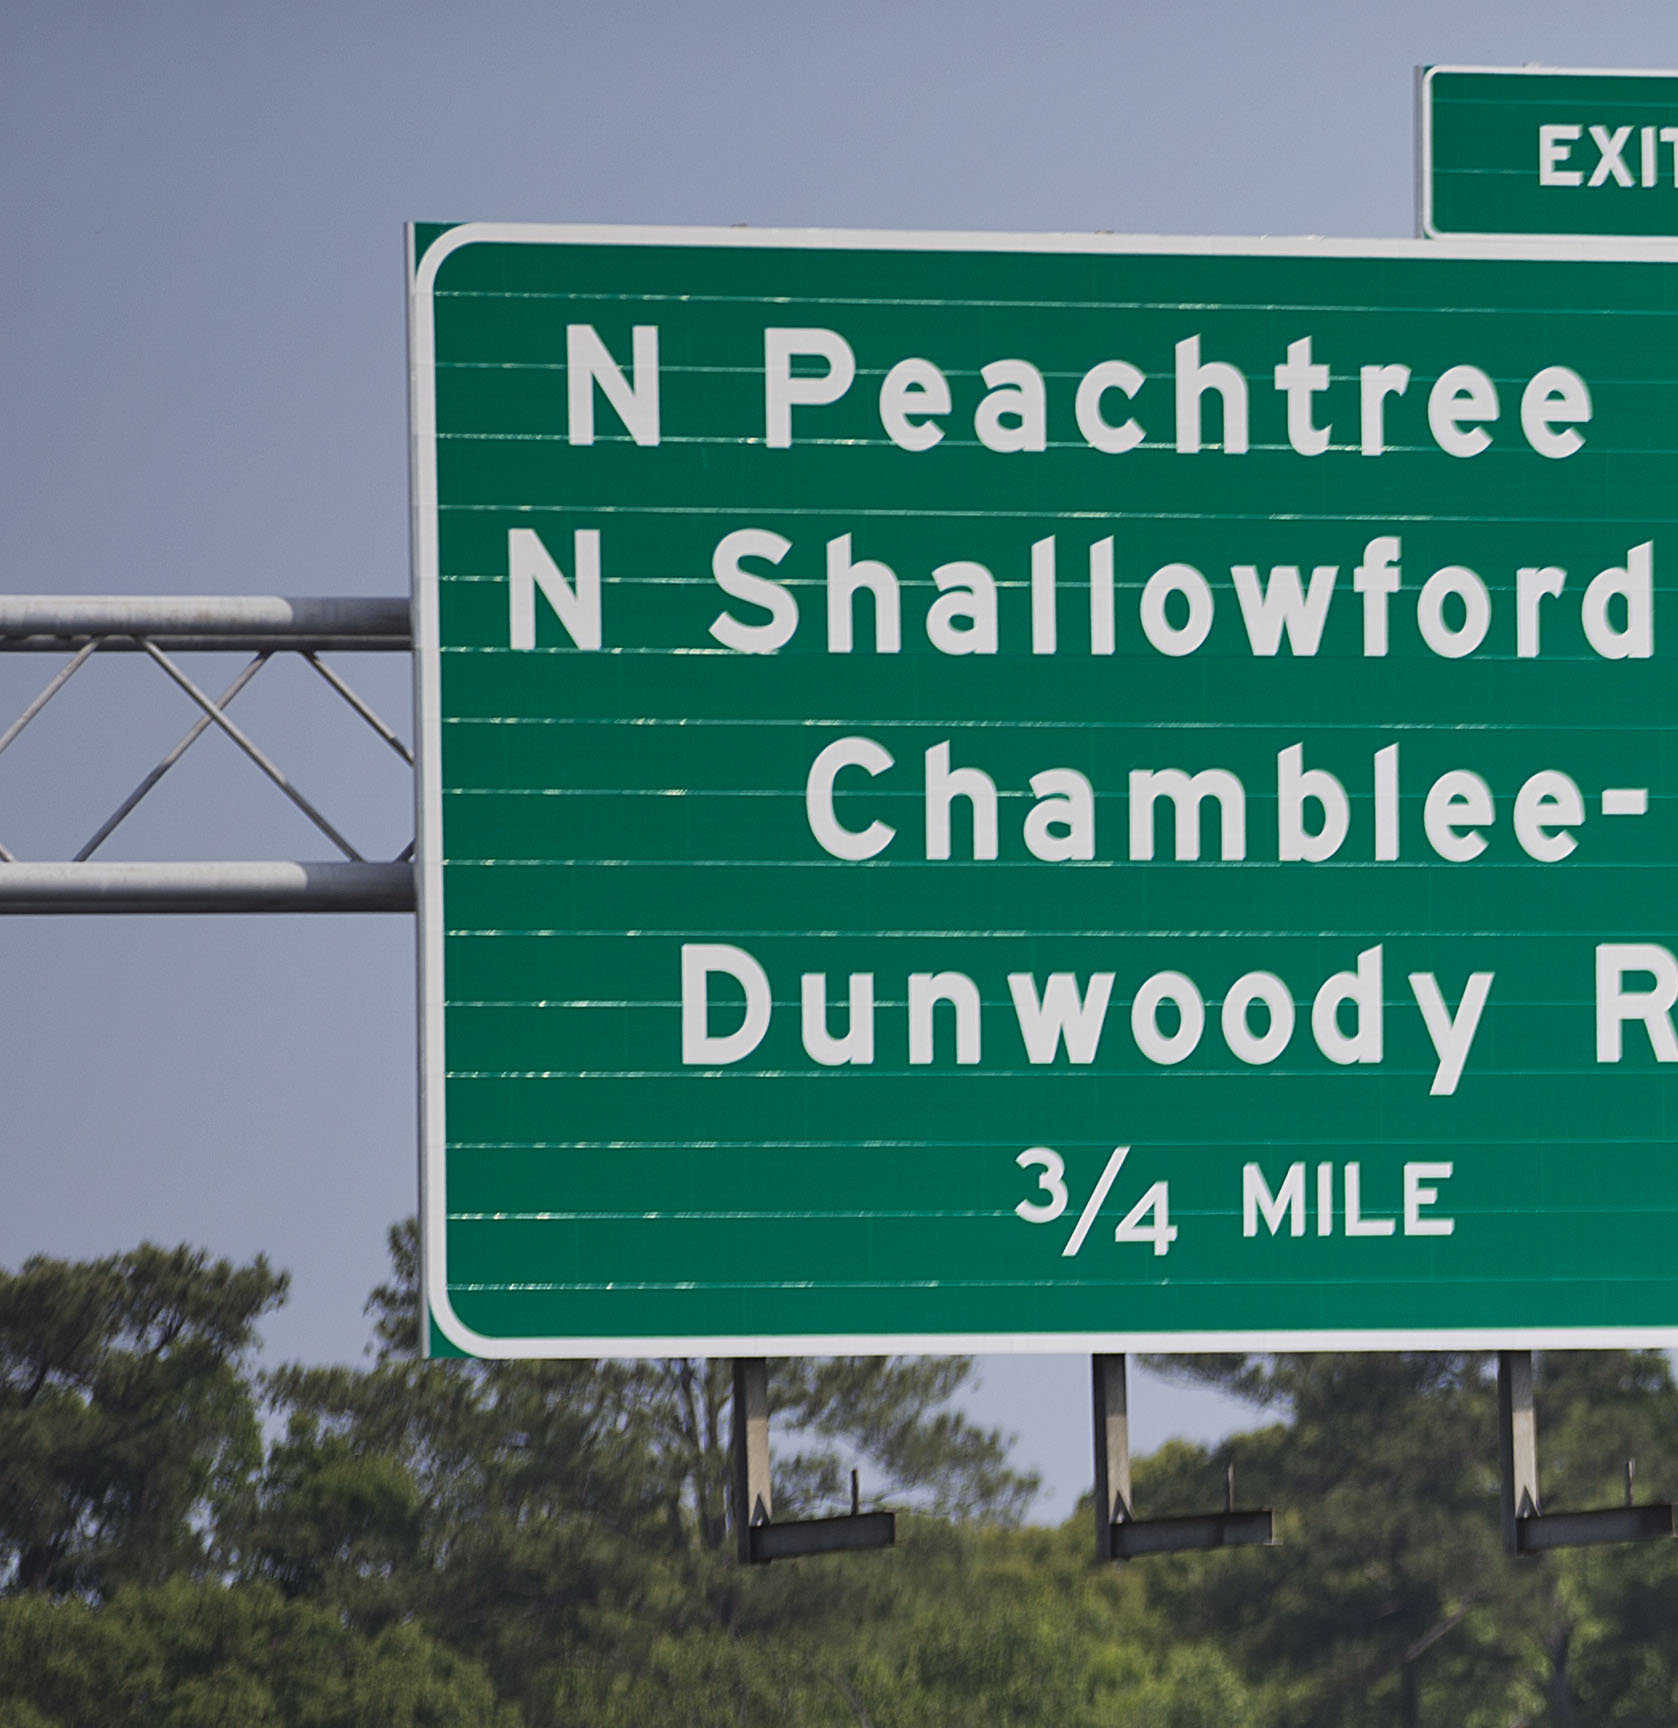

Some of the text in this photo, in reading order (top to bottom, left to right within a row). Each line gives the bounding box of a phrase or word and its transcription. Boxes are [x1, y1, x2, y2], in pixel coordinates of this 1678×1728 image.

[566, 323, 662, 447] N
[763, 326, 1593, 460] Peachtree
[507, 527, 603, 652] N
[708, 527, 1654, 661] Shallowford
[805, 736, 1650, 864] Chamblee-
[680, 942, 1495, 1097] Dunwoody
[1013, 1145, 1455, 1258] 3/4 MILE
